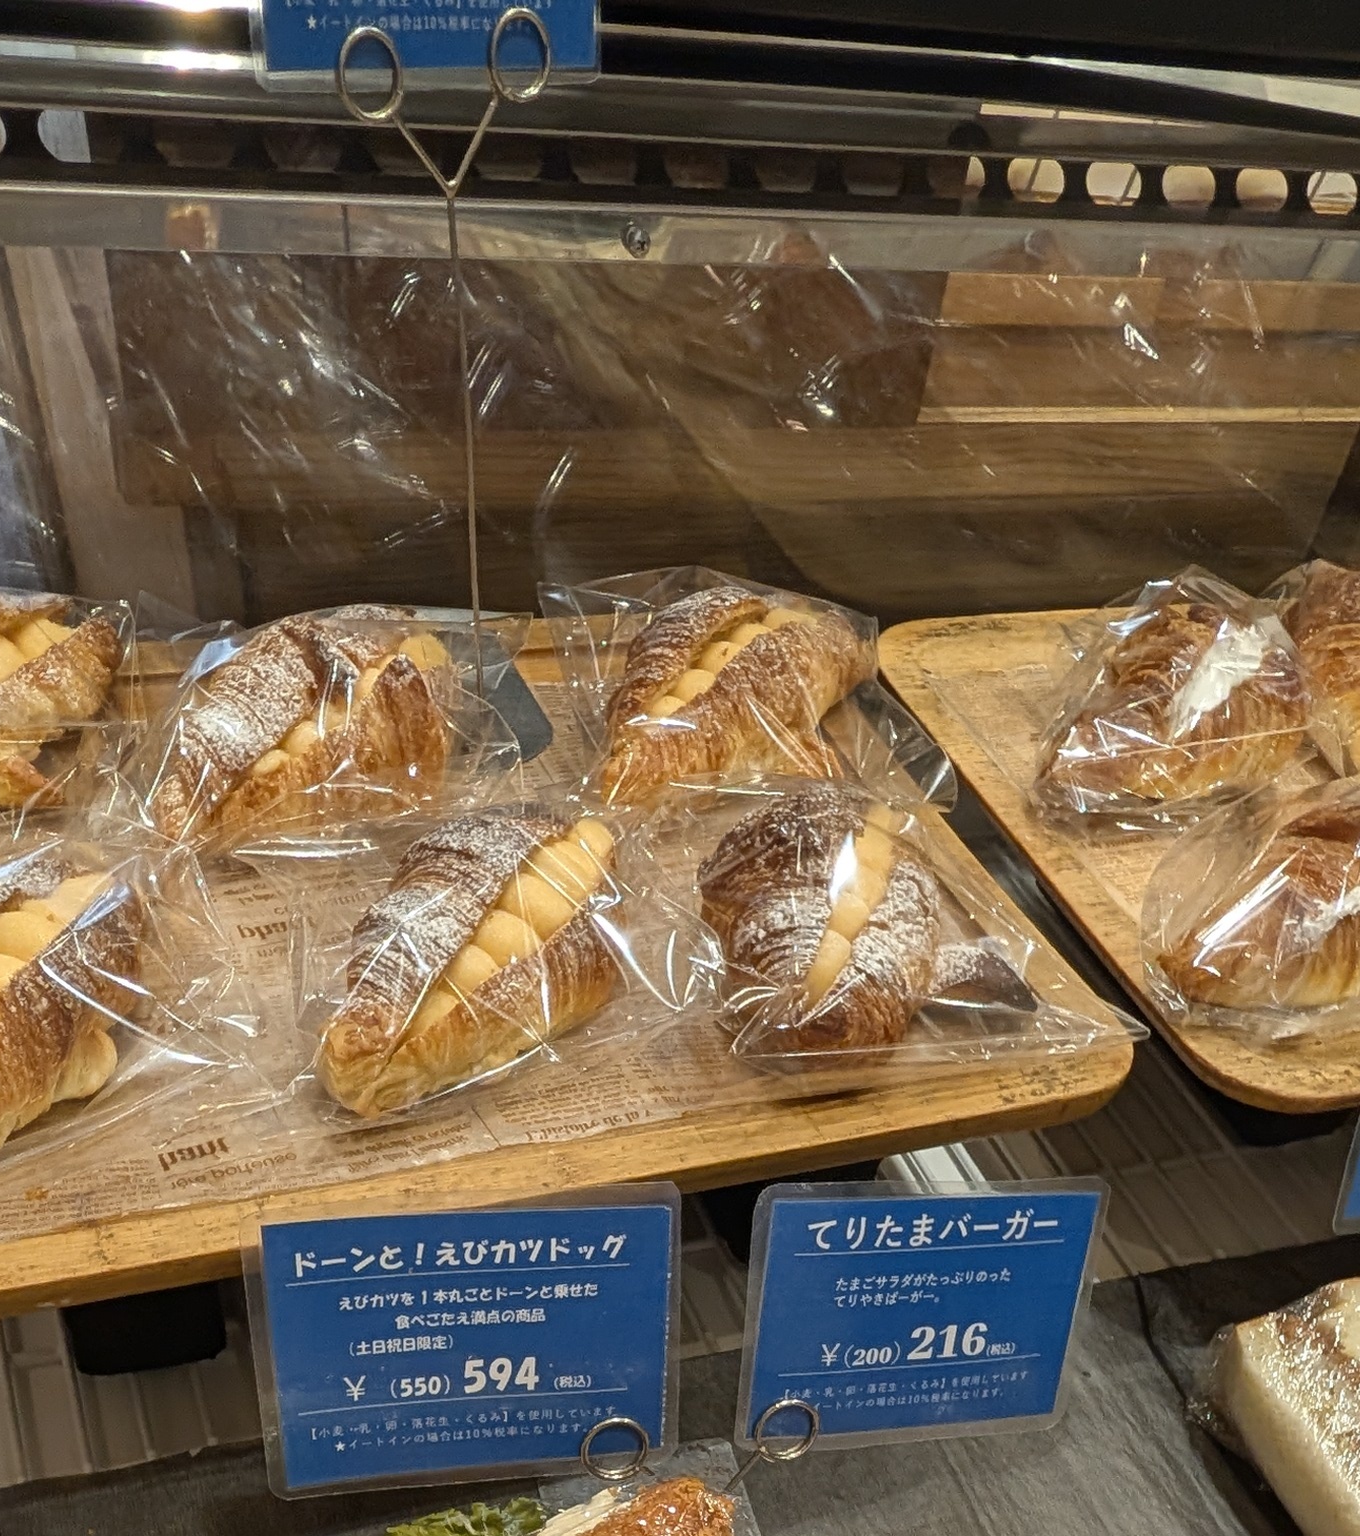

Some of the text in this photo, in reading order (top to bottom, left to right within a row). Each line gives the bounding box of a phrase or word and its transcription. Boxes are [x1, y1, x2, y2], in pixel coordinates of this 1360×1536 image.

[807, 1209, 1059, 1251] てりたまバーガー
[835, 1267, 1012, 1293] たまごサラダがたっぷりのった
[395, 1307, 546, 1330] 食べごたえ満点の商品
[348, 1334, 454, 1357] (土日祝日限定)
[820, 1321, 1016, 1369] ¥ (200) 216 (税込)
[343, 1356, 592, 1402] ¥ (550) 594 (税込)
